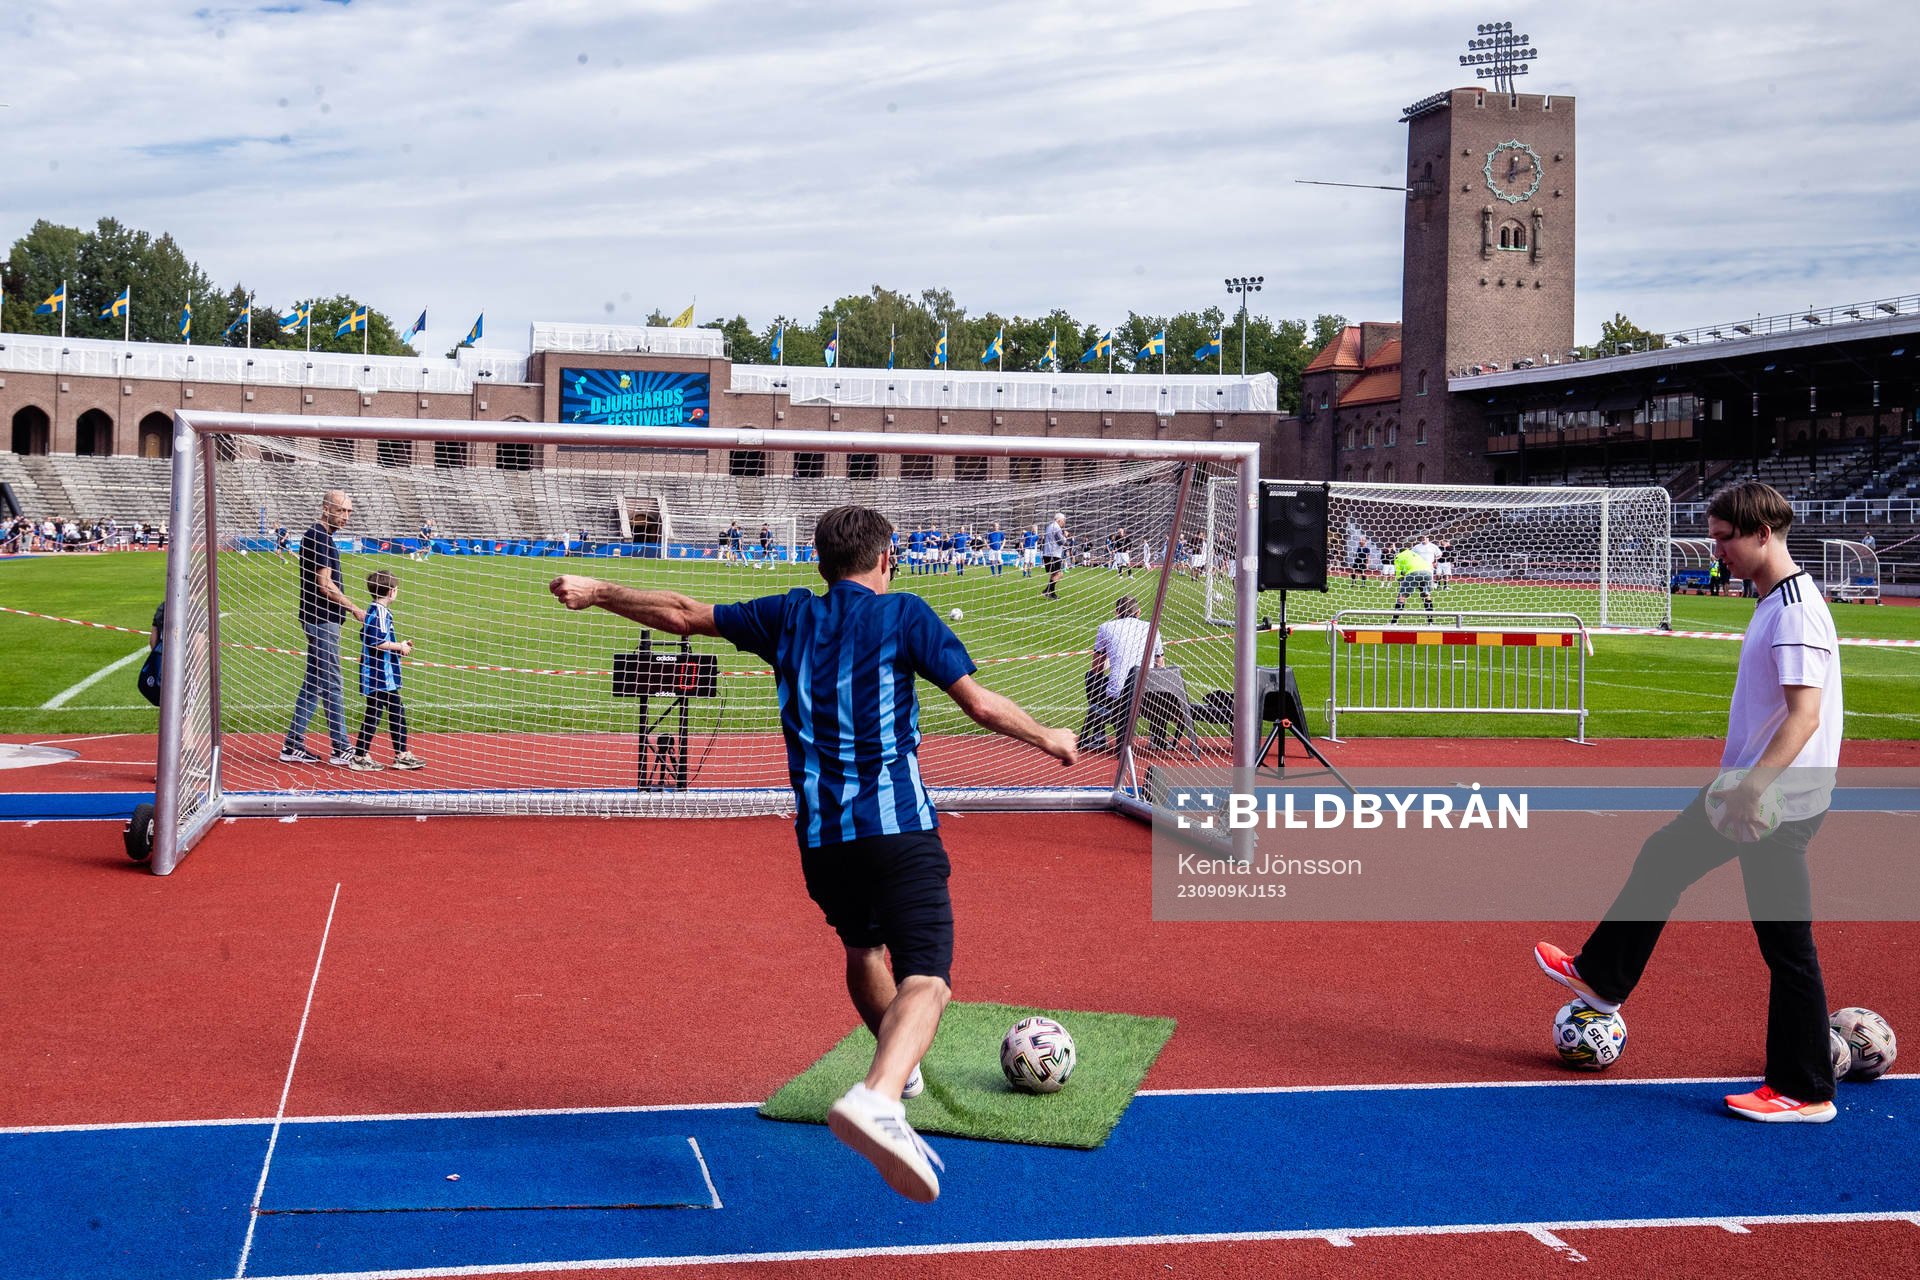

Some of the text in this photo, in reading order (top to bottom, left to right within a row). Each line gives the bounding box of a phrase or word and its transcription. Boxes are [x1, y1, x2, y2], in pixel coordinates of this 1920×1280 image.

[590, 387, 684, 414] DJURGÅRDS
[607, 406, 683, 426] FESTIVALEN
[1588, 1028, 1614, 1062] SELECT
